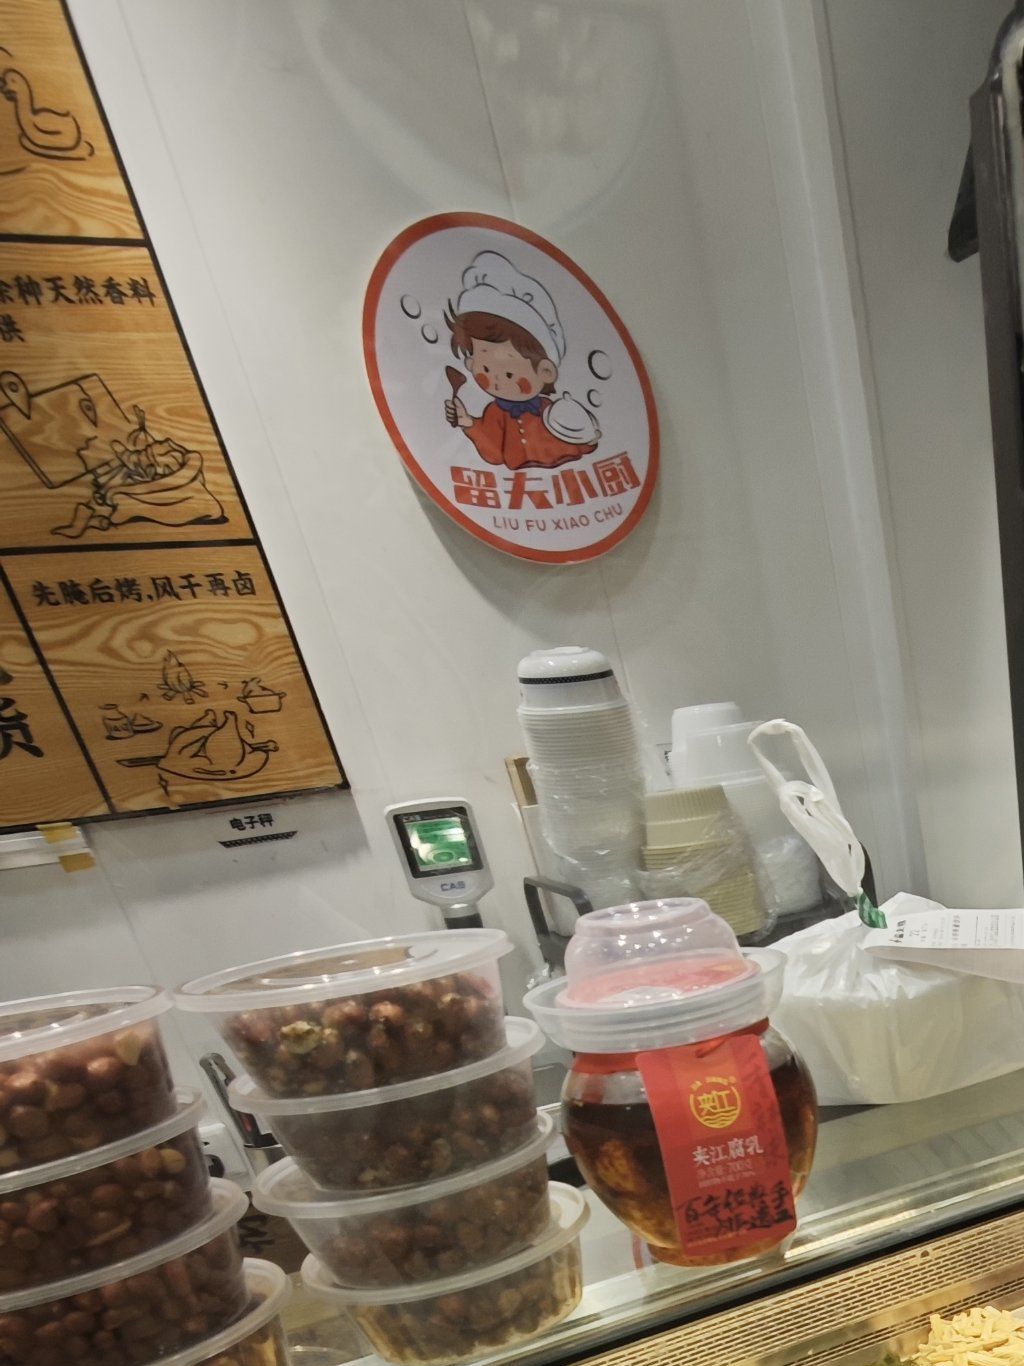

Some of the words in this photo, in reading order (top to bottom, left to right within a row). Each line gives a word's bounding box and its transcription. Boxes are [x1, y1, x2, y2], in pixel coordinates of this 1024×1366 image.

[450, 451, 641, 511] 留夫小厨
[492, 515, 519, 531] LIU
[526, 519, 546, 532] FU
[552, 514, 590, 530] XIAO
[594, 503, 623, 523] CHU
[440, 881, 466, 891] CAS
[692, 1135, 764, 1166] 夹江腐乳
